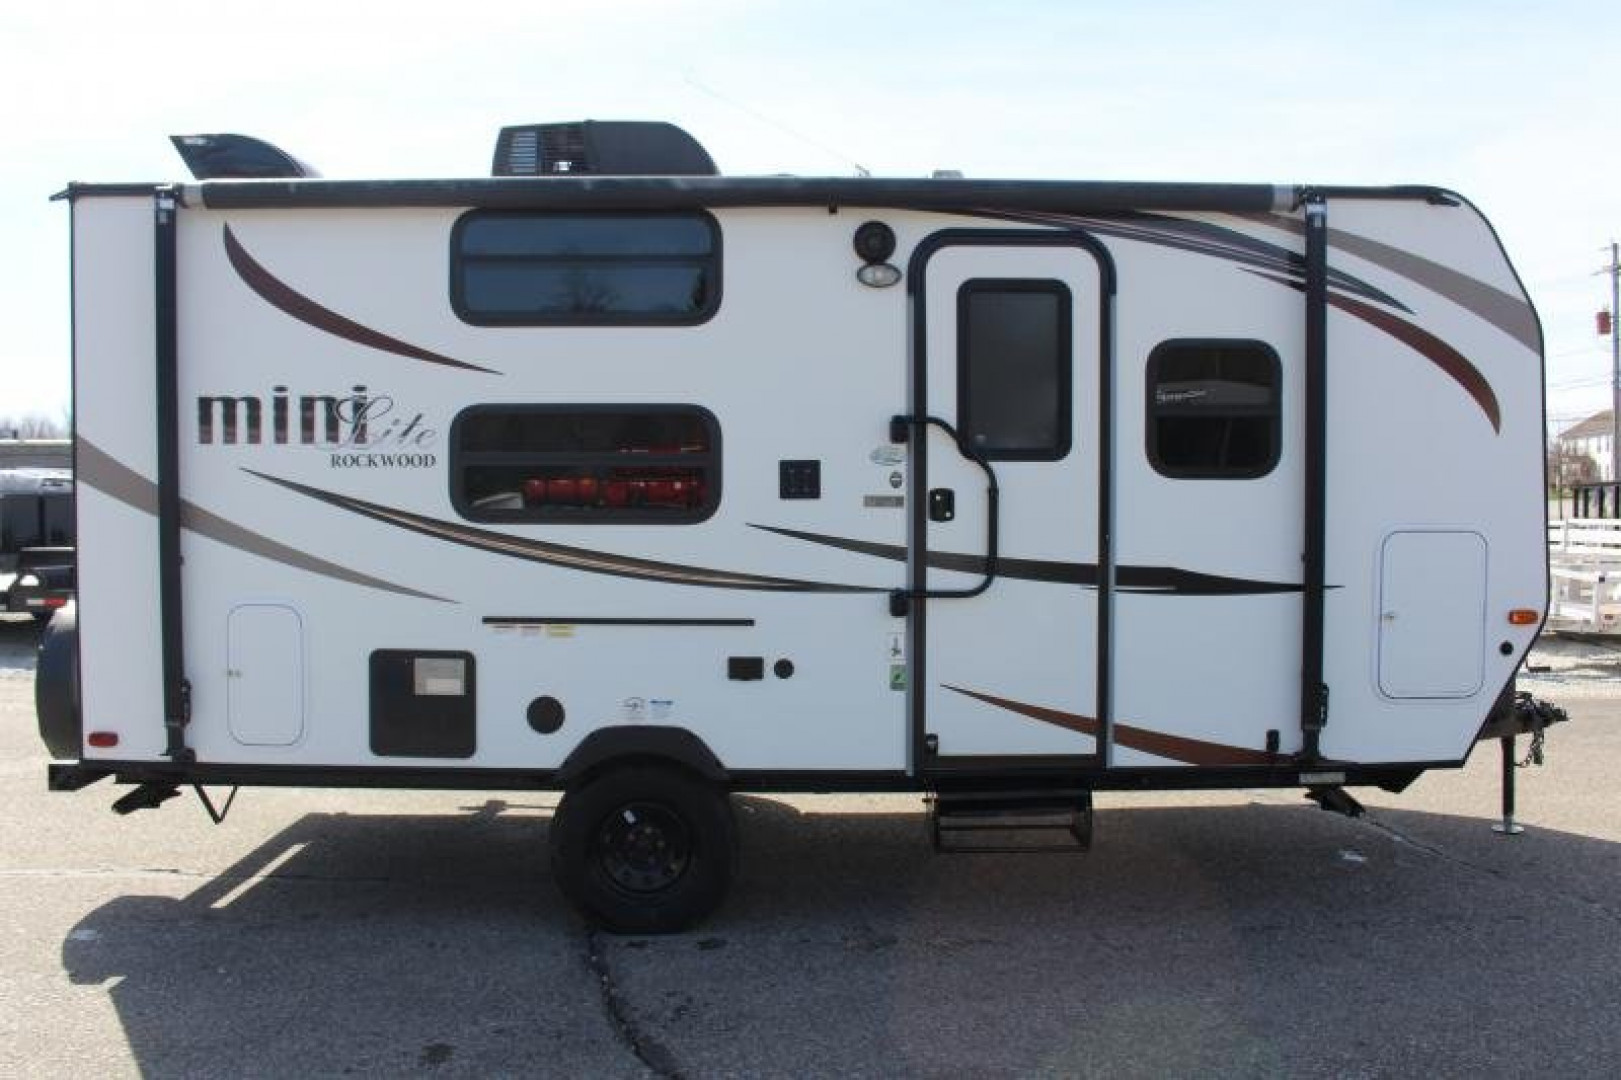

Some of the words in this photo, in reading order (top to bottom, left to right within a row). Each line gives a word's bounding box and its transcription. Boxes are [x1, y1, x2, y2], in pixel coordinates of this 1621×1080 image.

[197, 385, 368, 445] mini
[331, 396, 437, 450] Lite
[330, 453, 437, 468] ROCKWOOD
